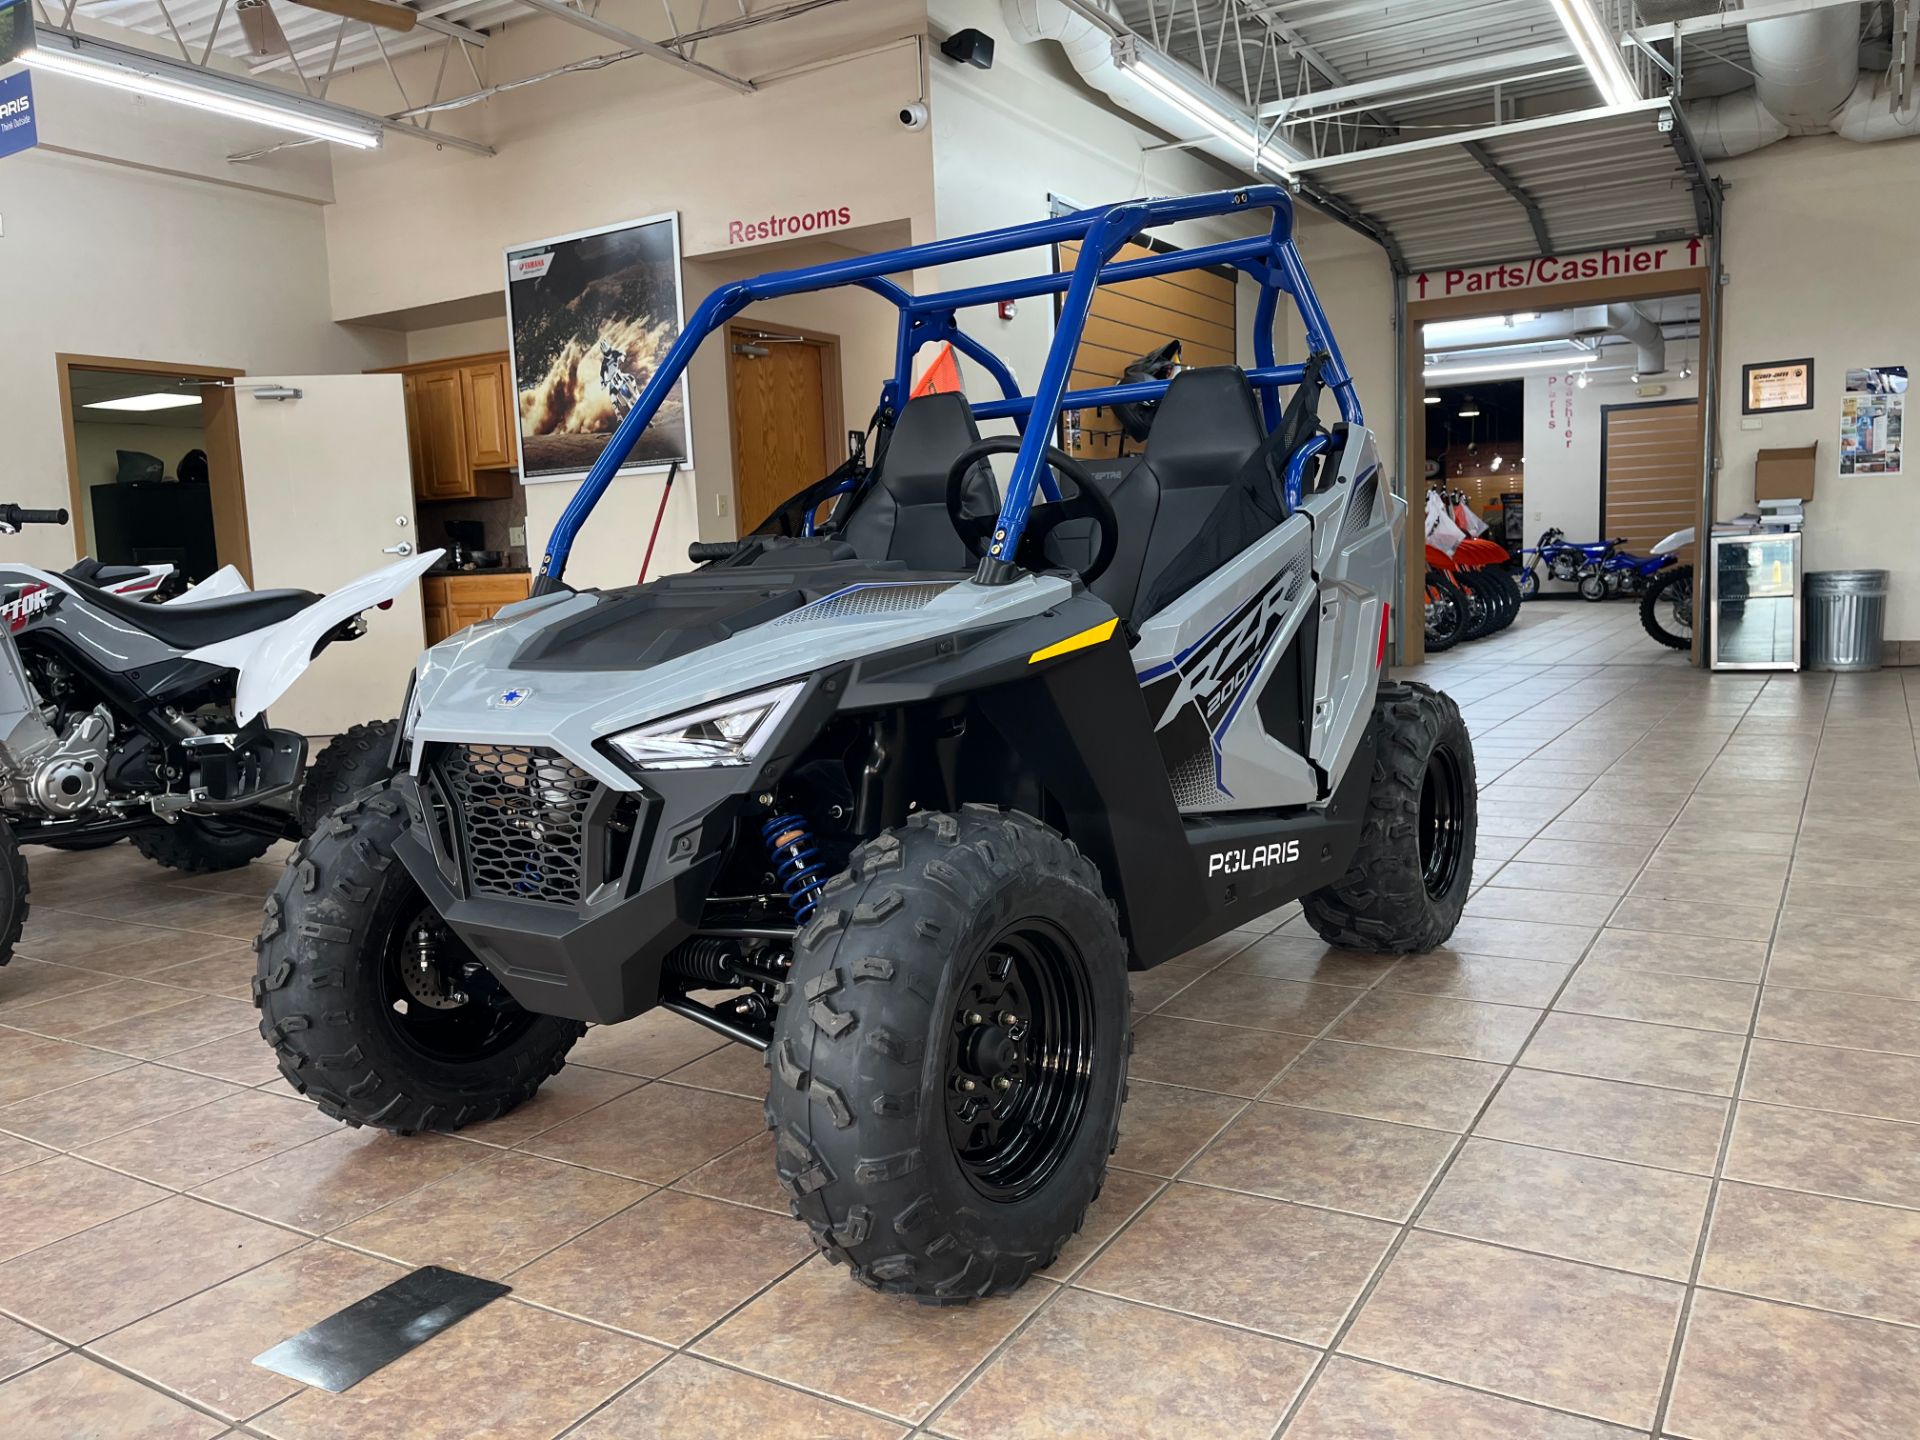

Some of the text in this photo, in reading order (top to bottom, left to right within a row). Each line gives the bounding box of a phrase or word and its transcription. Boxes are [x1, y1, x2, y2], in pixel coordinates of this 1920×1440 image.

[729, 206, 851, 244] Restrooms
[1445, 246, 1668, 295] Parts/Cashier
[1564, 374, 1574, 449] Cashier
[1154, 571, 1296, 732] RZR
[1207, 660, 1250, 719] 200
[1208, 839, 1300, 878] POLARIS
